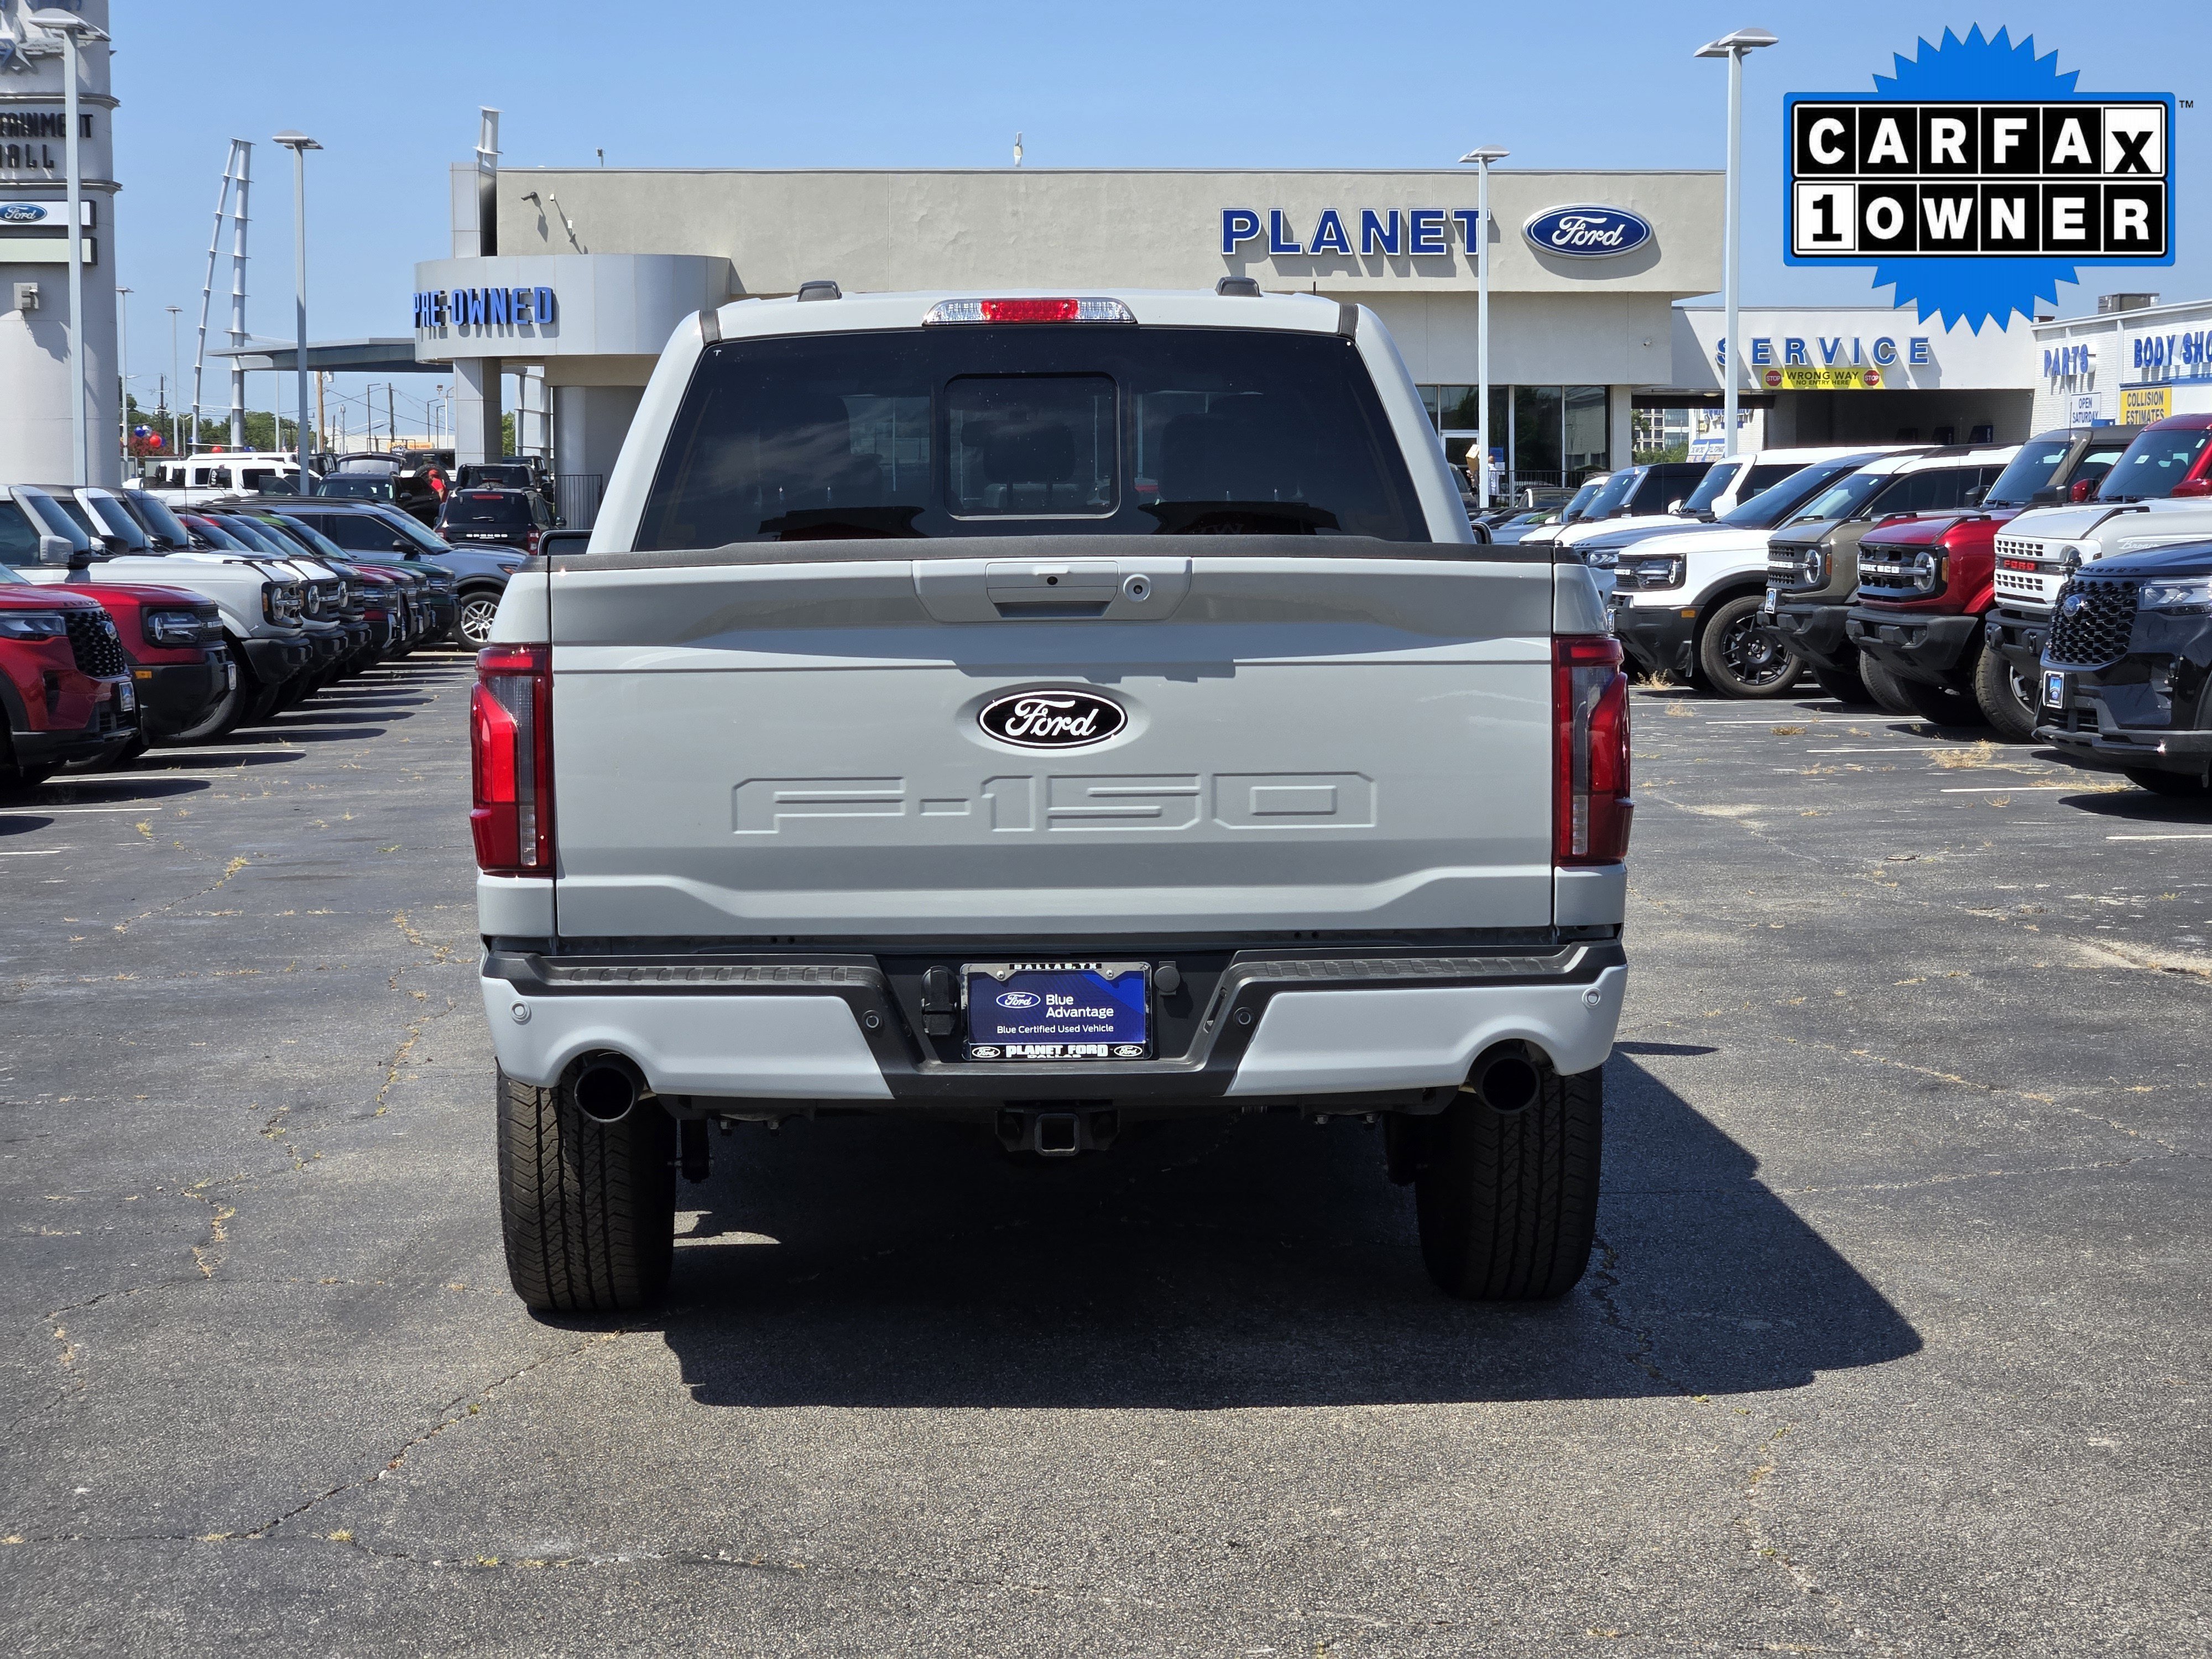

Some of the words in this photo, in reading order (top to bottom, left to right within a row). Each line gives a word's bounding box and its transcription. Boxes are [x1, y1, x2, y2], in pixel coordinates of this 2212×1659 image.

[0, 144, 55, 168] ALL
[4, 206, 37, 220] Ford
[1220, 208, 1491, 255] PLANET
[1552, 216, 1625, 246] Ford
[413, 286, 554, 328] PRE-OWNED
[2134, 335, 2176, 368] BODY
[2044, 343, 2089, 378] PARTS
[1786, 371, 1830, 380] WRONG
[1834, 371, 1859, 380] WAY
[2078, 397, 2093, 409] OPEN
[2127, 390, 2164, 408] COLLISION
[2072, 410, 2099, 424] SATURDAY
[2004, 560, 2035, 571] FORD
[1005, 698, 1099, 736] Ford
[732, 773, 1377, 834] F-150
[1004, 994, 1032, 1006] Ford
[1046, 993, 1074, 1005] Blue
[1046, 1006, 1114, 1019] Advantage
[997, 1025, 1016, 1034] Blue
[1018, 1024, 1056, 1034] Certified
[1057, 1024, 1081, 1033] Used
[1082, 1024, 1114, 1033] Vehicle
[1005, 1045, 1063, 1058] PLANET
[1067, 1044, 1108, 1057] FORD
